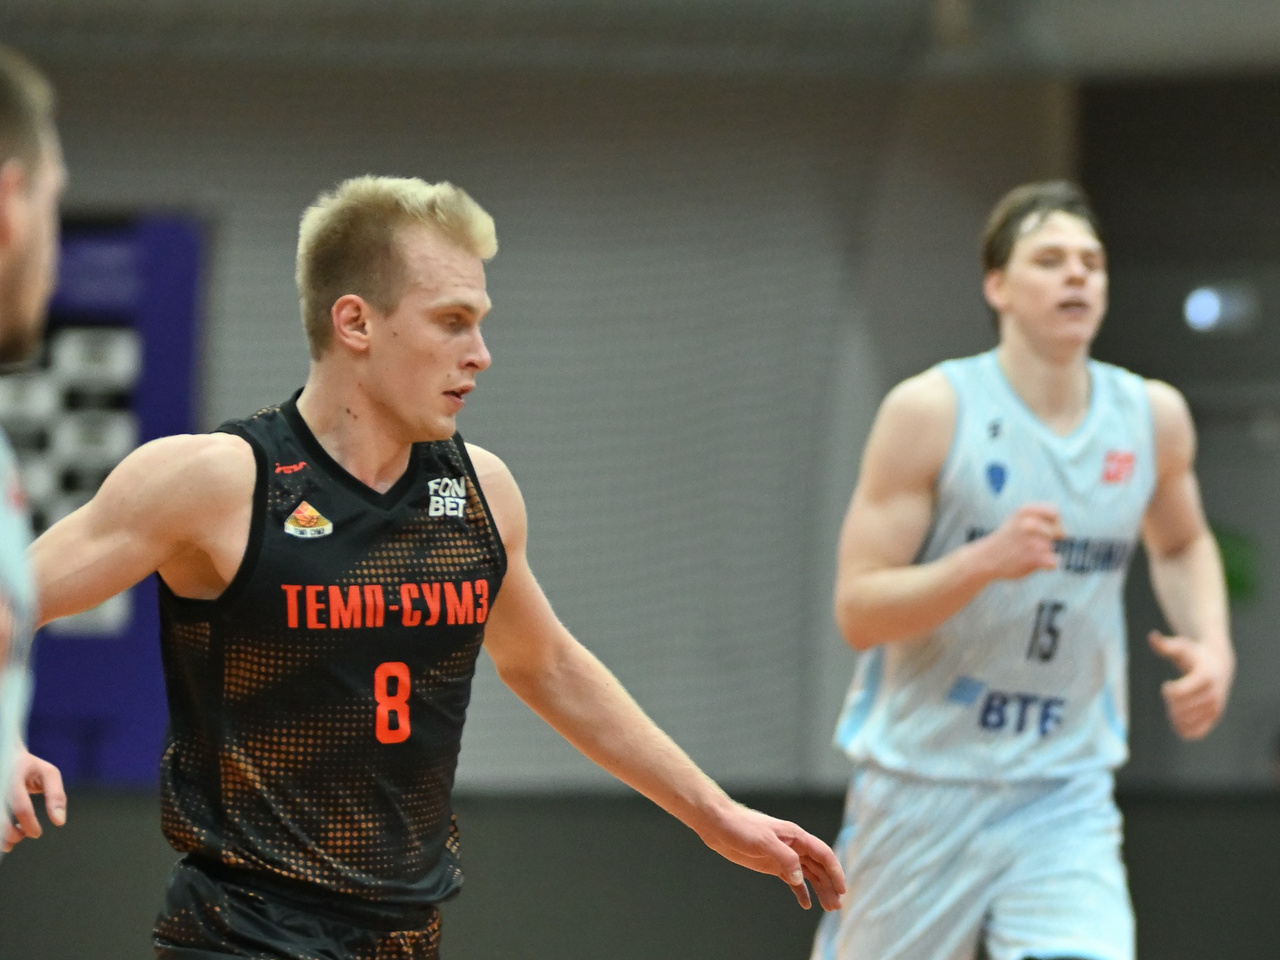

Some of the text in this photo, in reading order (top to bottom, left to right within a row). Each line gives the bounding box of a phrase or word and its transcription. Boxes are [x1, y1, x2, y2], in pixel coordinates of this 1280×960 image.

[428, 477, 466, 498] FON
[428, 497, 467, 517] BET
[281, 579, 489, 630] ТЕМП-СУМЗ
[1025, 598, 1063, 662] 15
[374, 661, 411, 744] 8
